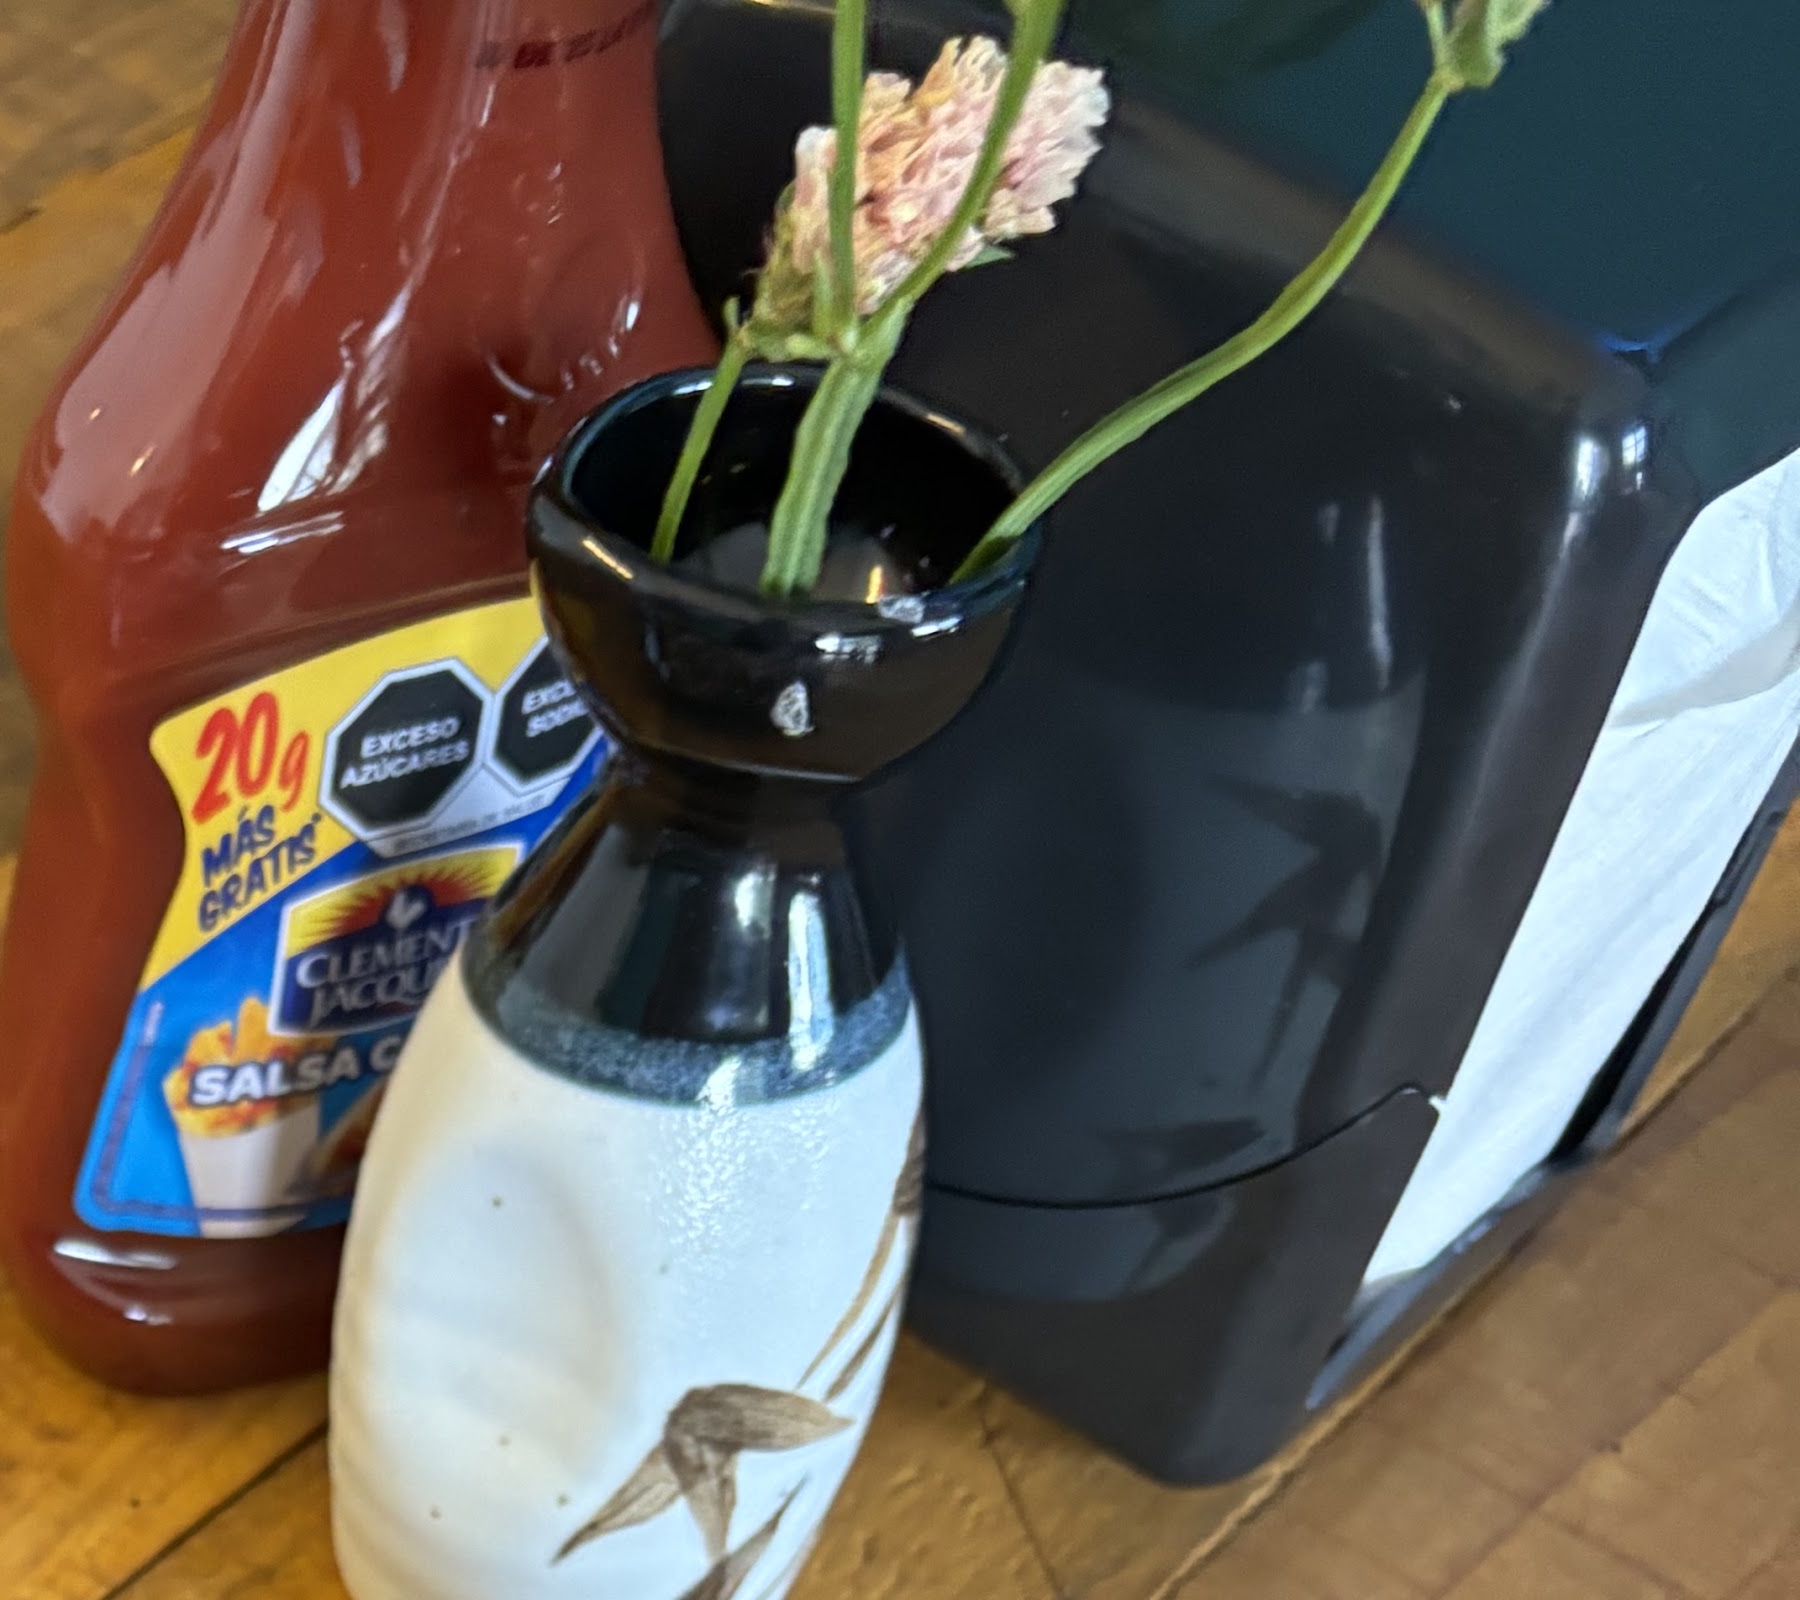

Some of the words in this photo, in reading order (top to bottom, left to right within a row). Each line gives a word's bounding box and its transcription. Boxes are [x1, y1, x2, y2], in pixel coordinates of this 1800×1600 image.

[191, 691, 309, 824] 20g
[339, 740, 470, 790] AZÚCARES
[361, 717, 460, 760] EXCESO
[202, 805, 275, 889] MÁS
[296, 917, 480, 989] CLEMENT
[310, 957, 443, 1029] JACQU
[191, 1046, 361, 1107] SALSA
